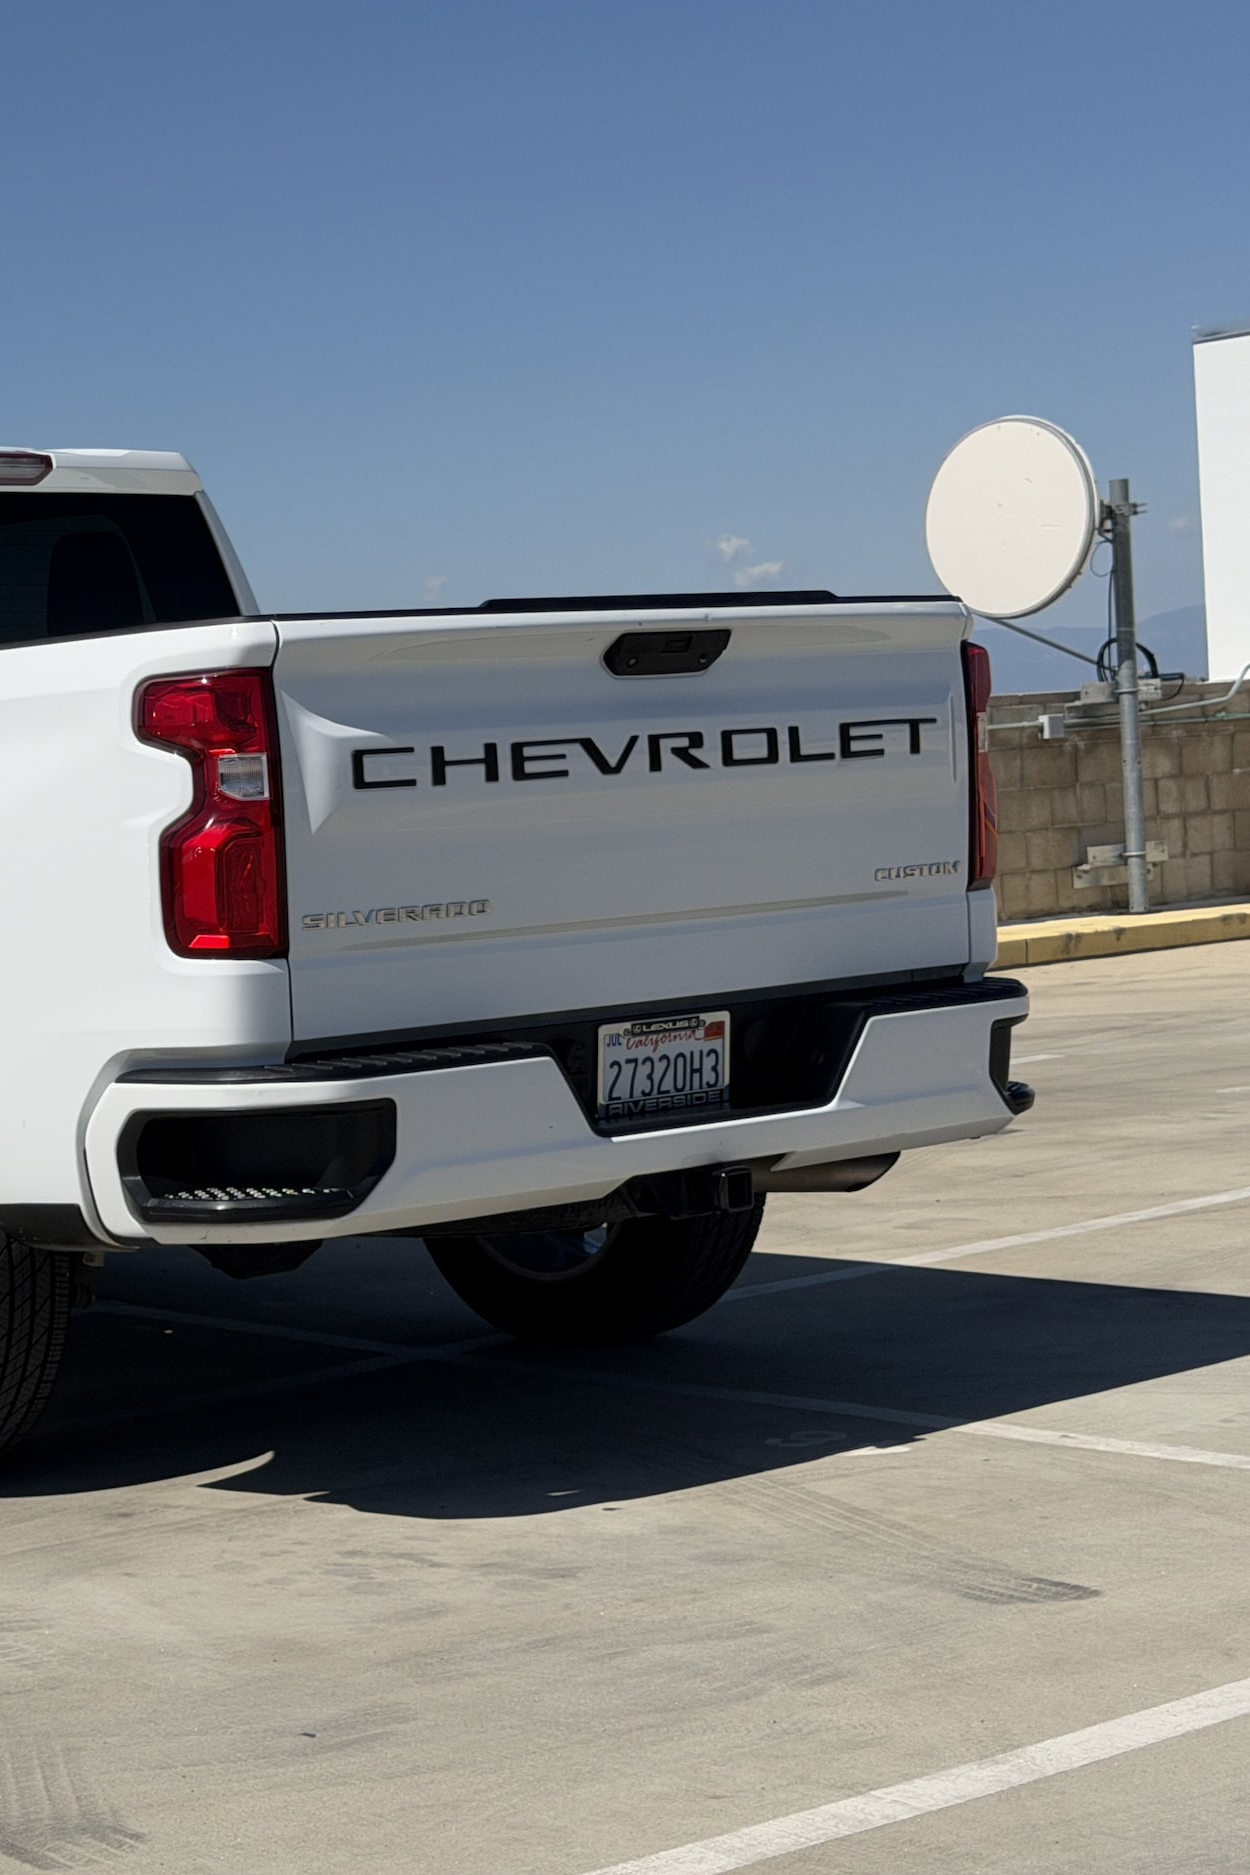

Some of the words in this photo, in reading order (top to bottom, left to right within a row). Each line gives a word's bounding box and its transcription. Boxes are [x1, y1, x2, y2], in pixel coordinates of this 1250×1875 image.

[351, 717, 938, 790] CHEVROLET
[874, 860, 962, 881] CUSTOM
[301, 898, 492, 932] SILVERADO
[642, 1019, 690, 1032] LEXUS
[626, 1030, 703, 1053] California
[608, 1048, 719, 1101] 27320H3
[607, 1090, 722, 1117] RIVERSIDE
